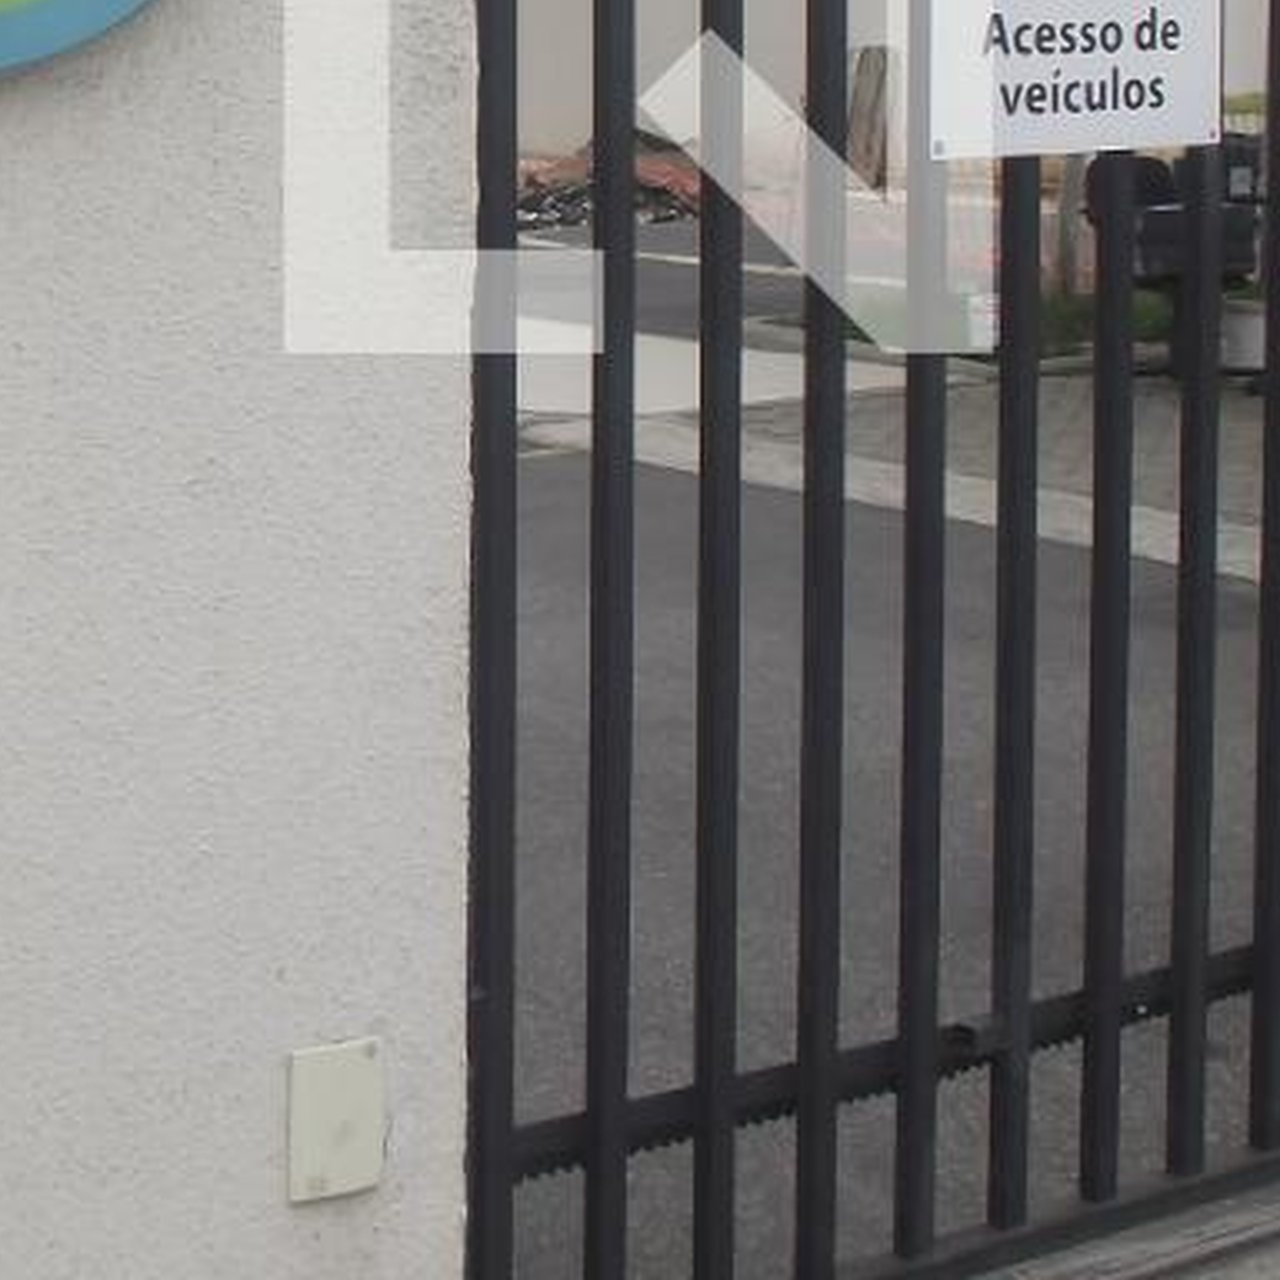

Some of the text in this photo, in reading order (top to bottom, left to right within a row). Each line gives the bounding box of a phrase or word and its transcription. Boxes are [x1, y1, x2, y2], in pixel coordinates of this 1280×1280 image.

[982, 5, 1181, 57] Acesso de
[999, 65, 1165, 116] veículos
